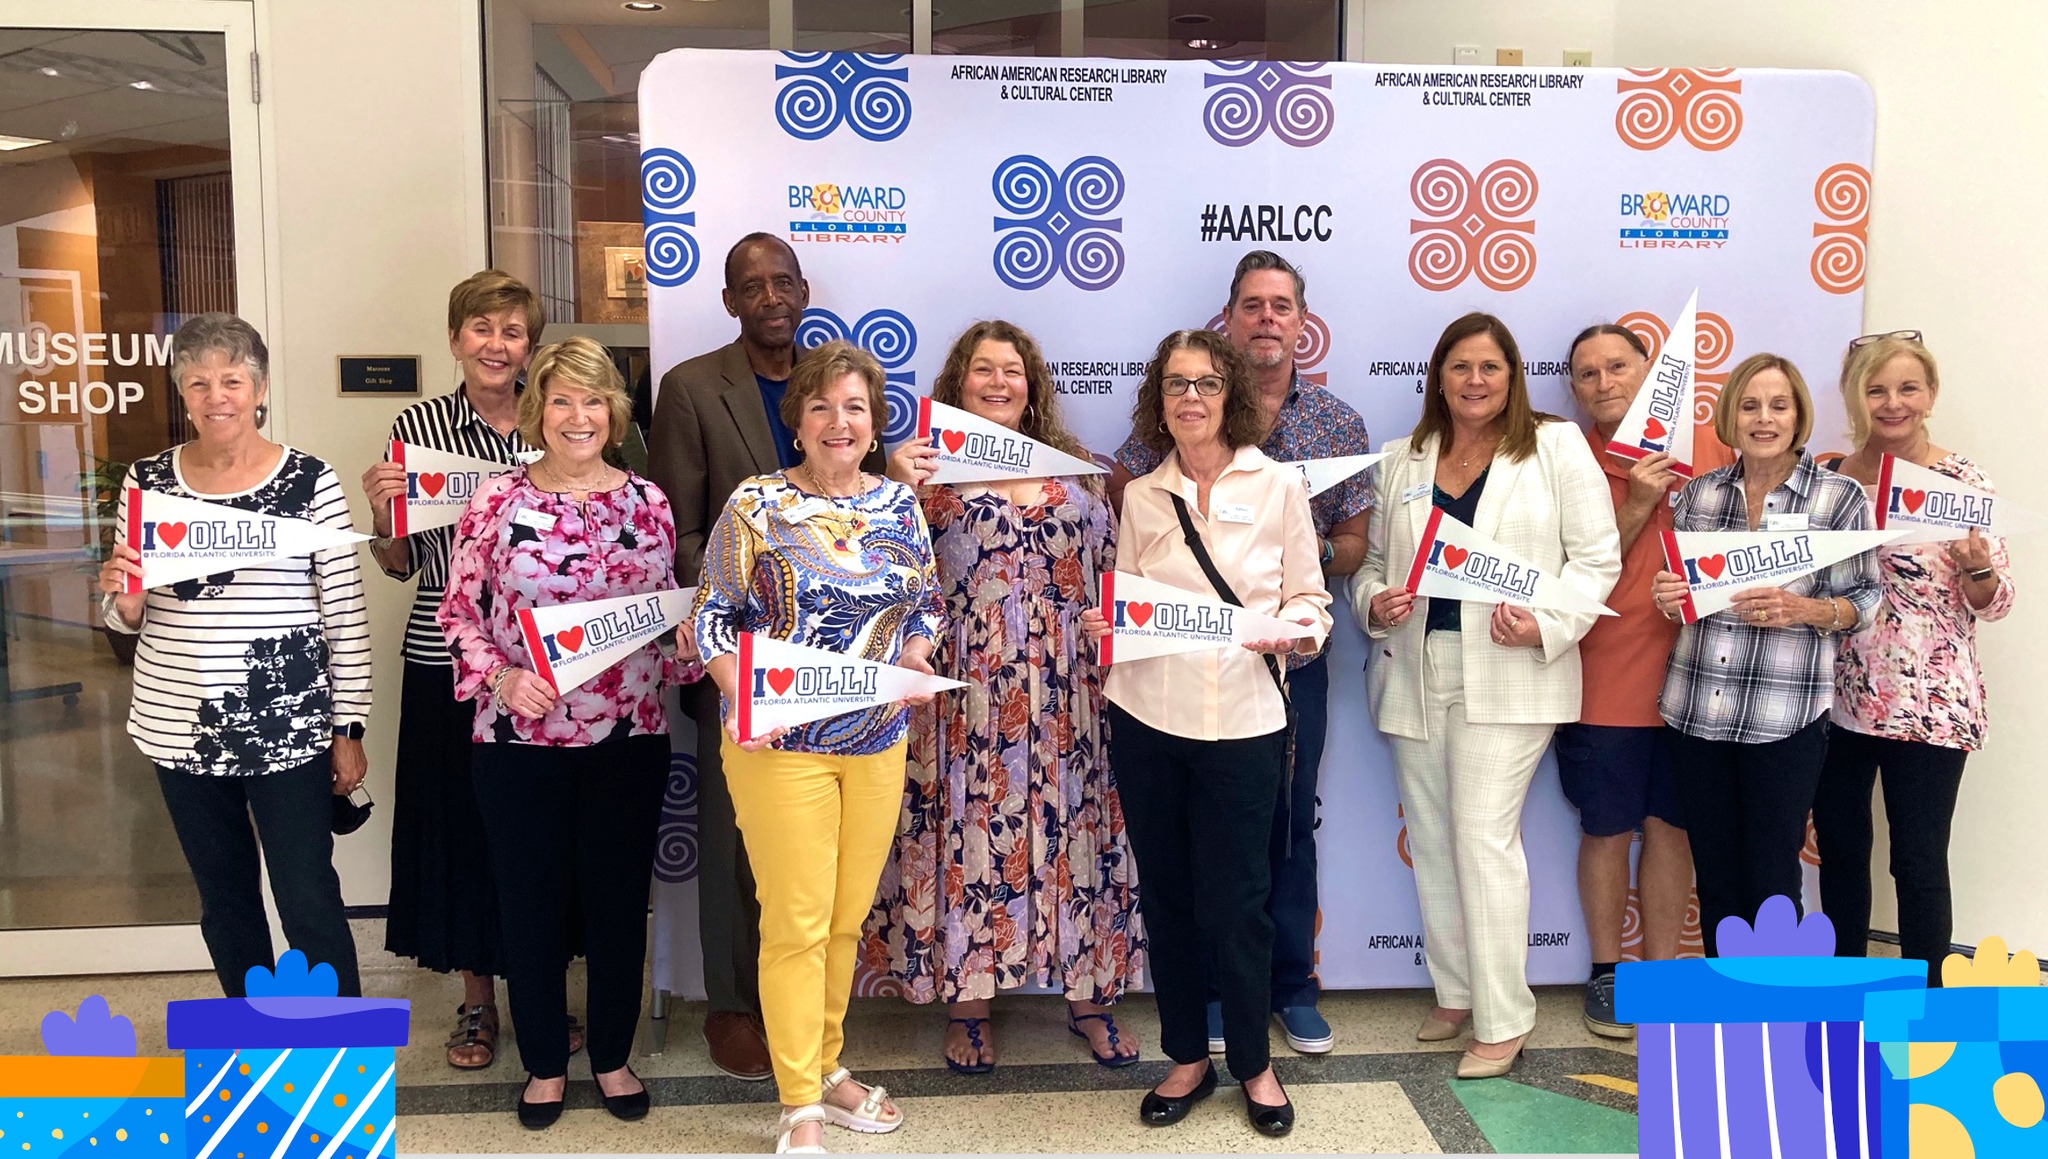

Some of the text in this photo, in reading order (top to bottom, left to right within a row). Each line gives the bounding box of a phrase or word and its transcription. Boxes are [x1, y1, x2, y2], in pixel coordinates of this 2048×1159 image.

[951, 65, 1167, 84] AFRICAN AMERICAN RESEARCH LIBRARY
[1375, 72, 1584, 89] AFRICAN AMERICAN RESEARCH LIBRARY
[1001, 85, 1113, 102] & CULTURAL CENTER
[1423, 91, 1531, 107] & CULTURAL CENTER
[788, 184, 906, 211] BROWARD
[1620, 193, 1730, 217] BROWARD
[843, 209, 906, 222] COUNTY
[1200, 204, 1333, 242] #AARLCC
[1670, 217, 1729, 229] COUNTY
[795, 223, 902, 232] FLORIDA
[1624, 230, 1725, 238] FLORIDA
[790, 233, 905, 243] LIBRARY
[1619, 240, 1727, 249] LIBRARY
[1061, 362, 1118, 376] RESEARCH
[1369, 361, 1415, 376] AFRICAN
[1531, 361, 1569, 376] LIBRAR
[379, 377, 393, 385] Shop
[1070, 380, 1113, 394] CENTER
[1415, 379, 1424, 394] &
[18, 381, 145, 415] SHOP
[1639, 354, 1686, 452] I OLLI
[1665, 426, 1676, 454] FLORIDA
[1672, 397, 1684, 425] ATLANTIC
[930, 427, 1033, 468] I OLLI
[930, 454, 961, 463] FLORIDA
[962, 459, 992, 469] ATLANTIC
[407, 472, 419, 499] I
[1889, 486, 1993, 526] I OLLI
[1922, 518, 1953, 528] ATLANTIC
[142, 520, 276, 550] I OLLI
[1684, 535, 1814, 585] I OLLI
[1428, 539, 1539, 597] I OLLI
[1460, 576, 1491, 591] ATLANTIC
[1731, 573, 1768, 585] ATLANTIC
[1114, 600, 1233, 636] I OLLI
[542, 595, 665, 662] I OLLI
[1153, 630, 1189, 639] ATLANTIC
[591, 639, 626, 655] ATLANTIC
[753, 666, 878, 698] I OLLI
[794, 696, 830, 704] ATLANTIC
[1368, 935, 1413, 949] AFRICAN
[1527, 932, 1571, 947] LIBRARY
[1414, 952, 1422, 966] &
